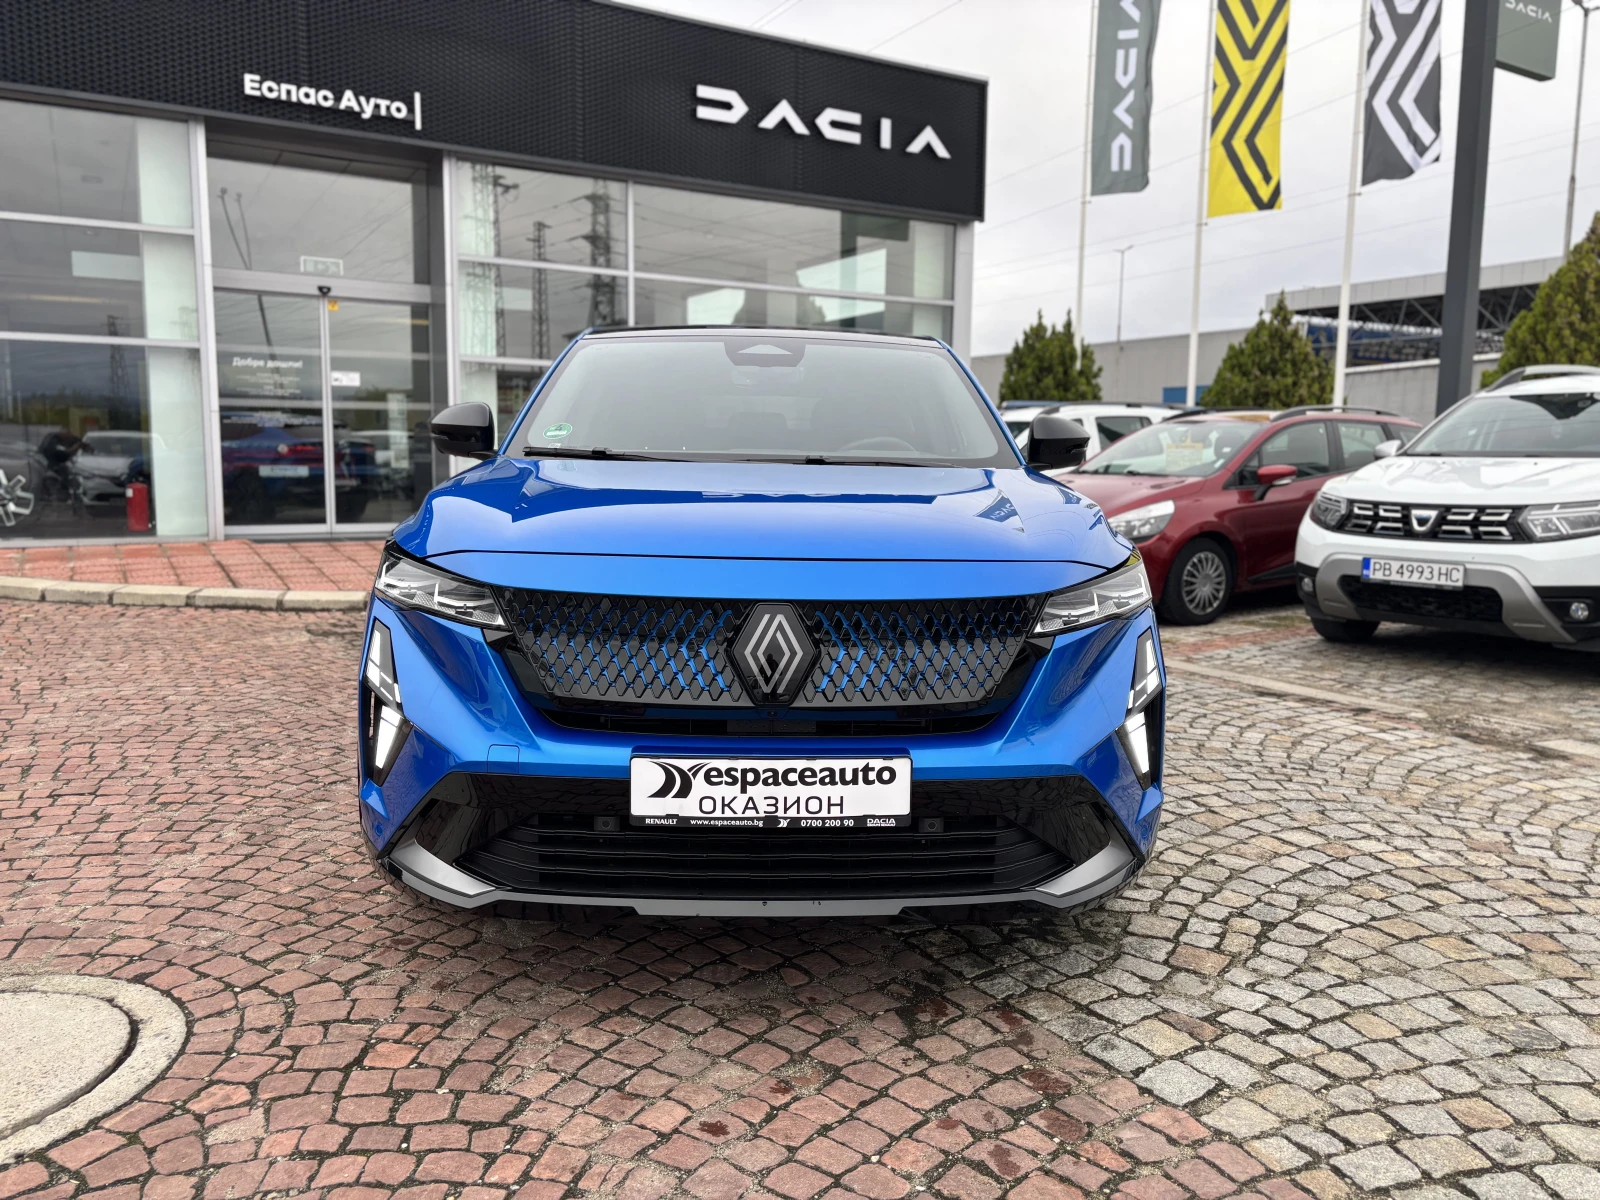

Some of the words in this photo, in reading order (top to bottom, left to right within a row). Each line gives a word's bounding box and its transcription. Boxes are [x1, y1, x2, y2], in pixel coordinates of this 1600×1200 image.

[1505, 0, 1553, 23] DACIA
[243, 72, 335, 108] Еспас
[338, 89, 408, 120] Ауто
[696, 84, 951, 159] DACIA
[1372, 561, 1392, 577] PB
[1396, 563, 1434, 581] 4993
[1438, 566, 1460, 583] HC
[703, 761, 897, 794] espaceauto
[698, 795, 844, 815] ОКАЗИОН
[690, 819, 764, 827] www.espaceauto.bg
[800, 819, 822, 827] 0700
[824, 819, 841, 827] 200
[843, 819, 855, 827] 90
